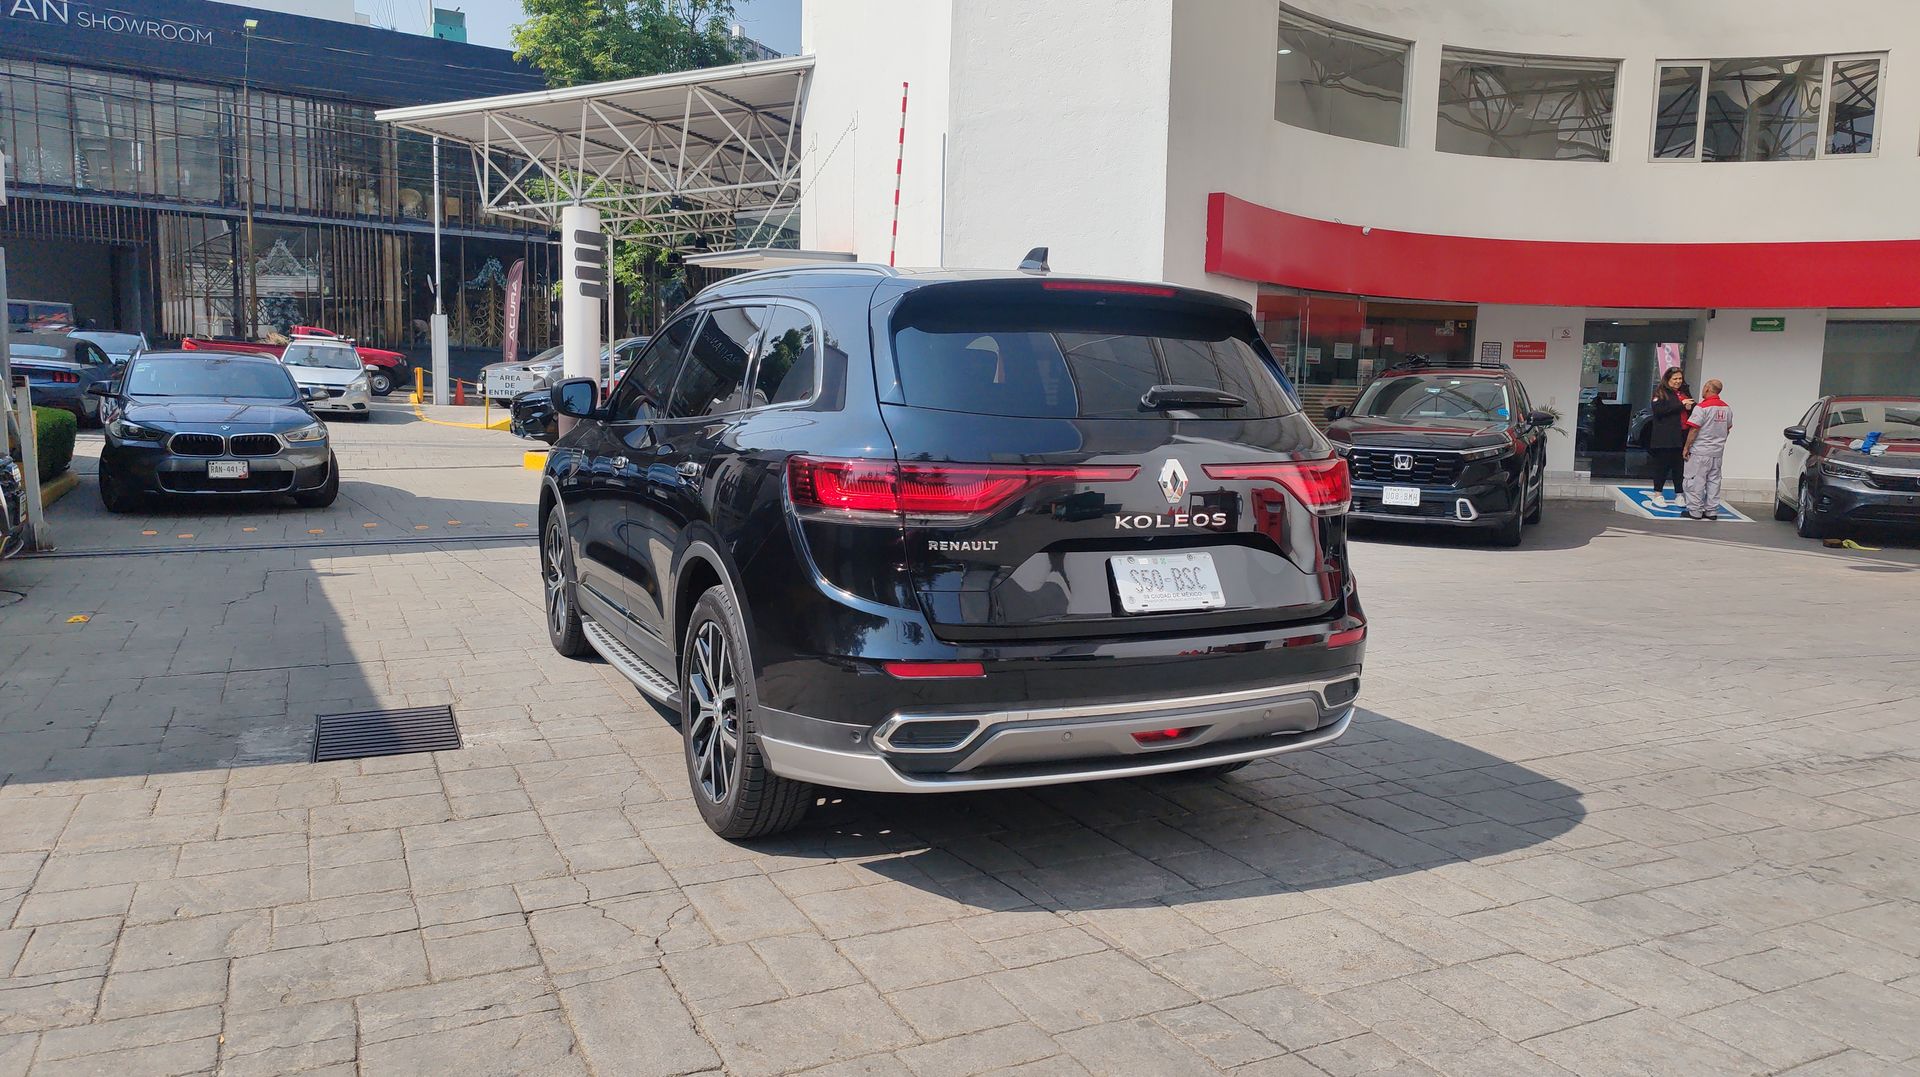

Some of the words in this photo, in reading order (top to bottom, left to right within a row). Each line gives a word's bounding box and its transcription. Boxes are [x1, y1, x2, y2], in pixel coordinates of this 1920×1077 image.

[0, 0, 69, 25] AN
[77, 11, 213, 46] SHOWROOM
[508, 279, 519, 342] ACURA
[488, 389, 523, 397] ENTREG
[1114, 513, 1228, 530] KOLEOS
[927, 540, 999, 552] RENAULT
[1129, 567, 1206, 592] S50-BSC
